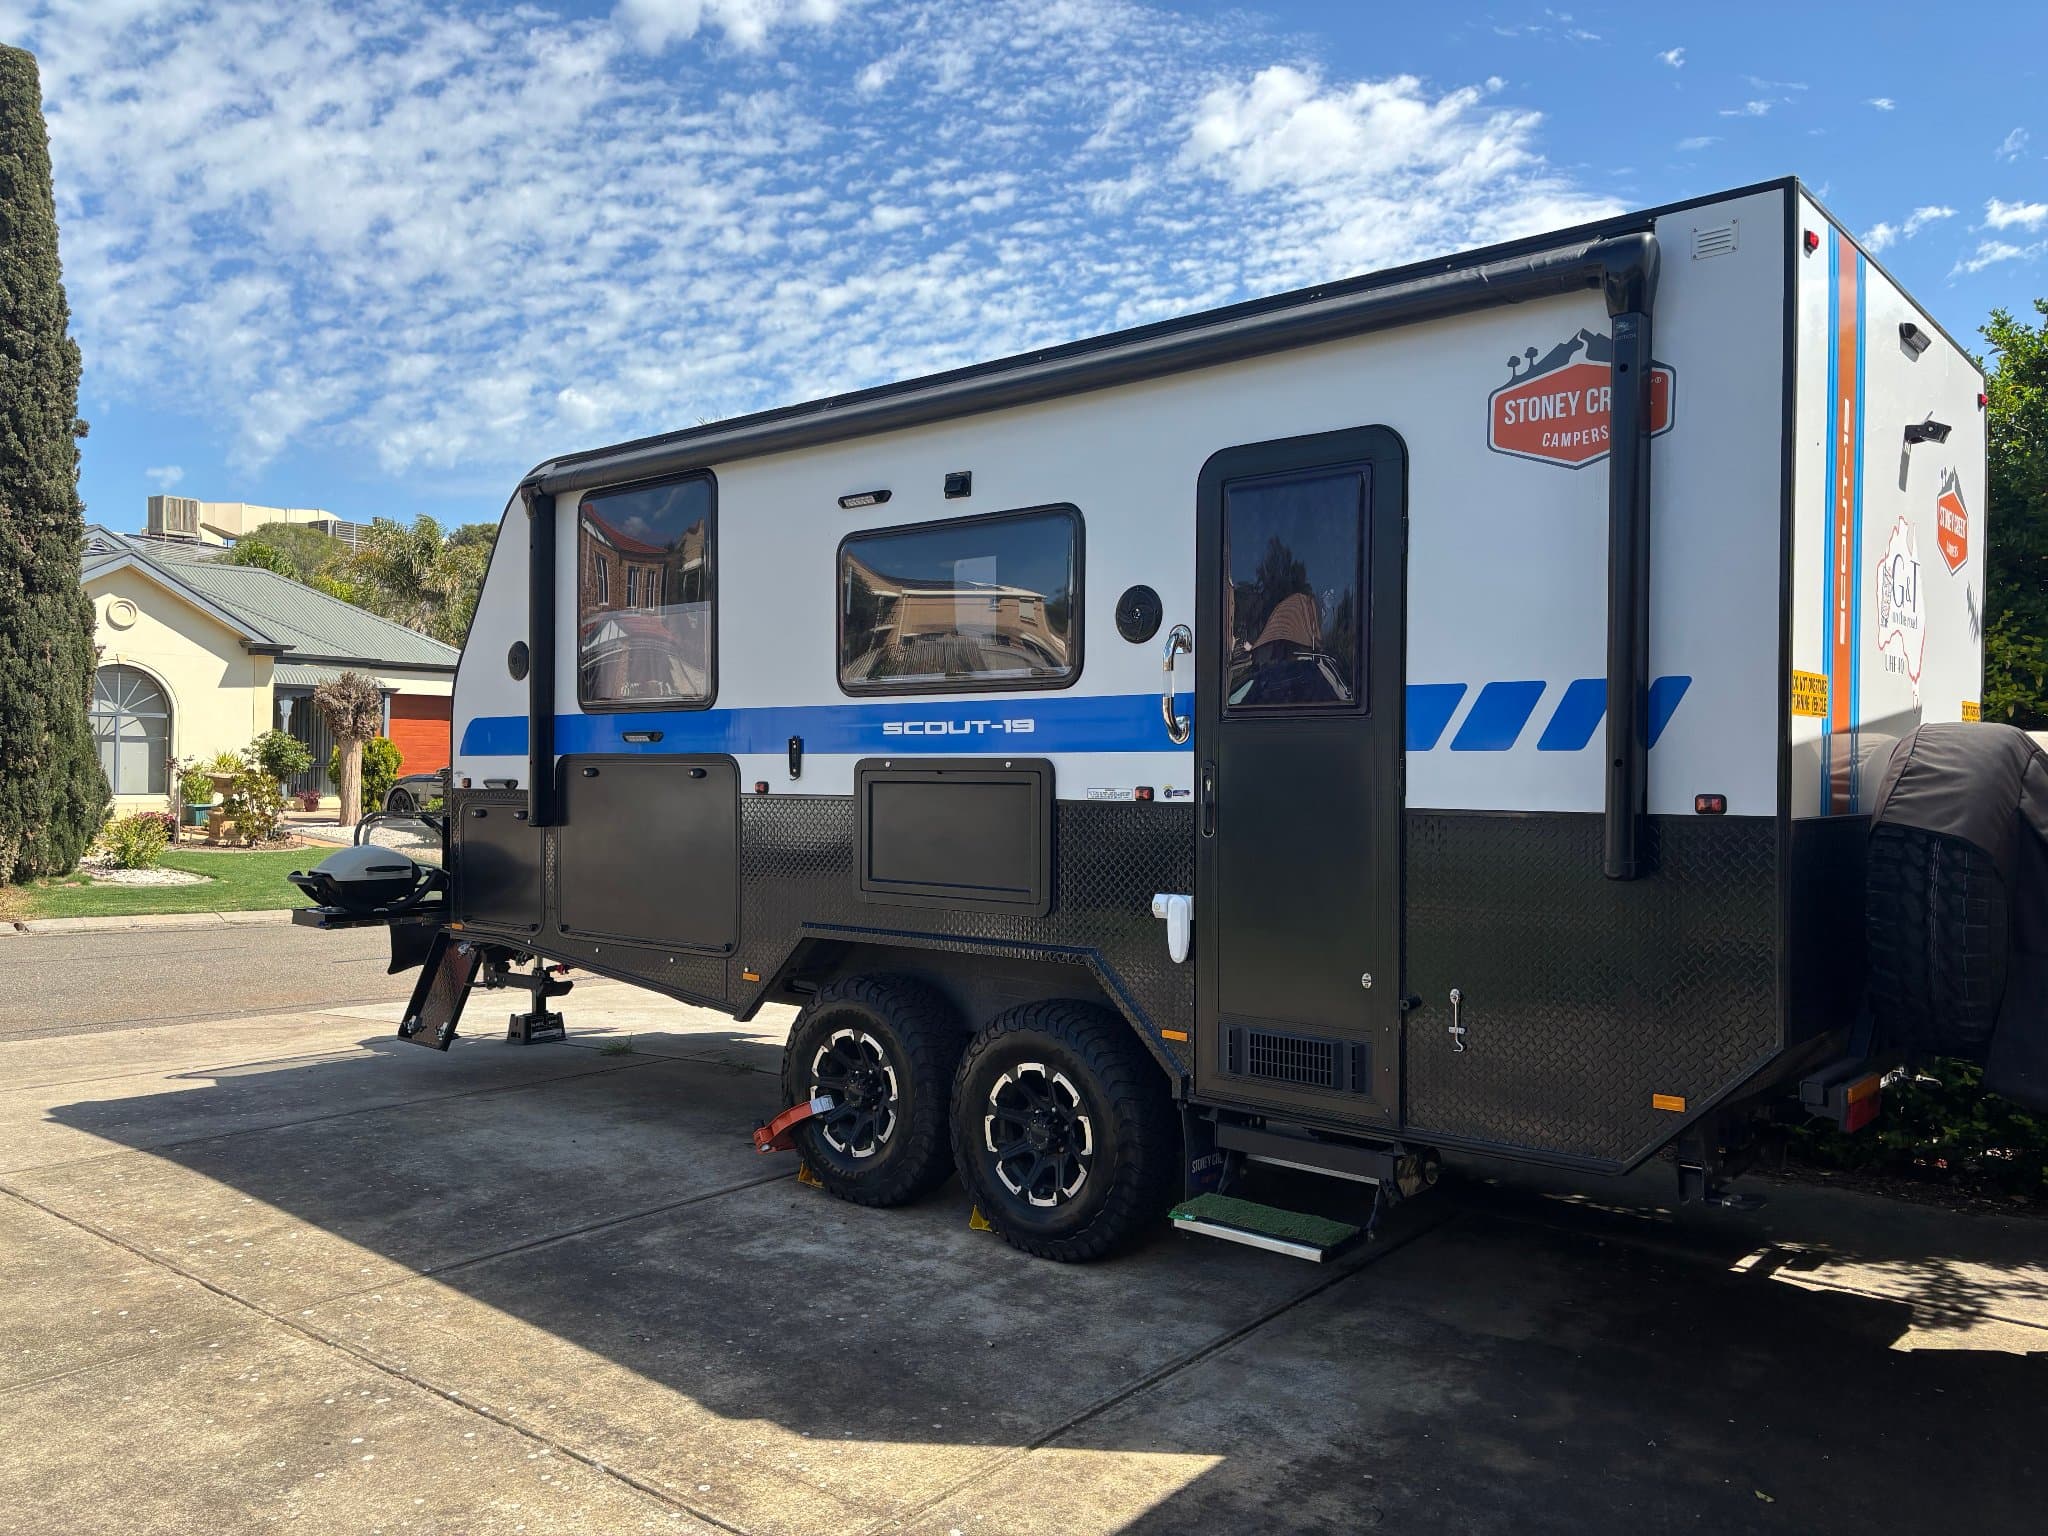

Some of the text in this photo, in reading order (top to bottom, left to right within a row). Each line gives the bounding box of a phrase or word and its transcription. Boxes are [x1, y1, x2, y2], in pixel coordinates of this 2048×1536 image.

[1504, 390, 1581, 425] STONEY
[1542, 424, 1609, 448] CAMPERS
[882, 718, 1035, 735] SCOUT-19
